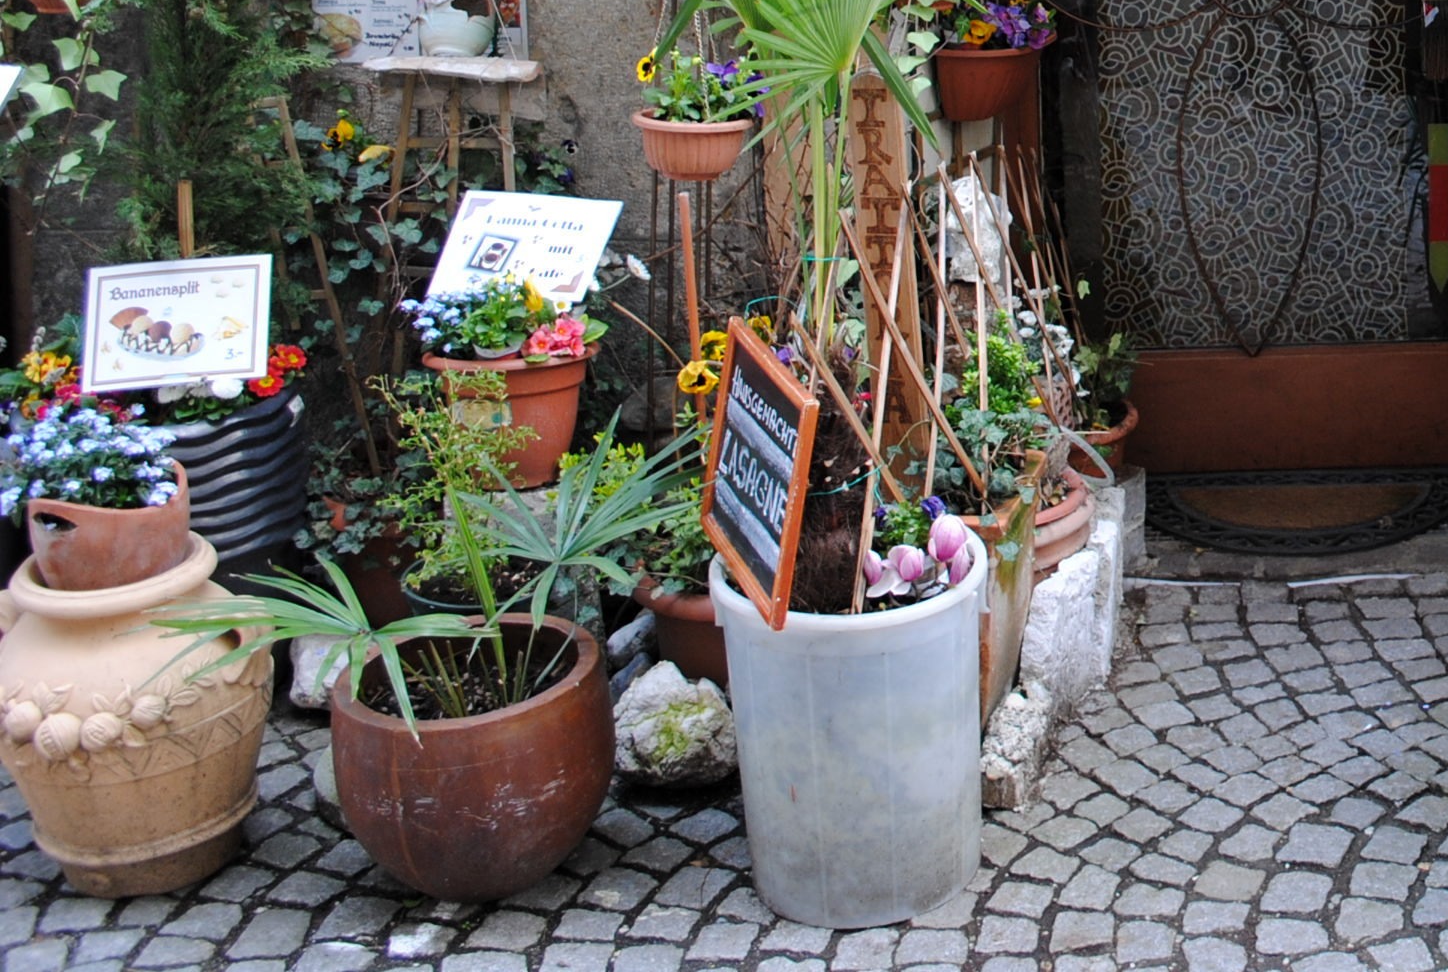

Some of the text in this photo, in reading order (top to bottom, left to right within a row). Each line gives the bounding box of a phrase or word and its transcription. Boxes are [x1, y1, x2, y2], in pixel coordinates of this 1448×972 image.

[109, 280, 201, 301] Bananensplit
[731, 364, 799, 459] HAUSGEMACHT
[718, 428, 789, 535] LASAGNE
